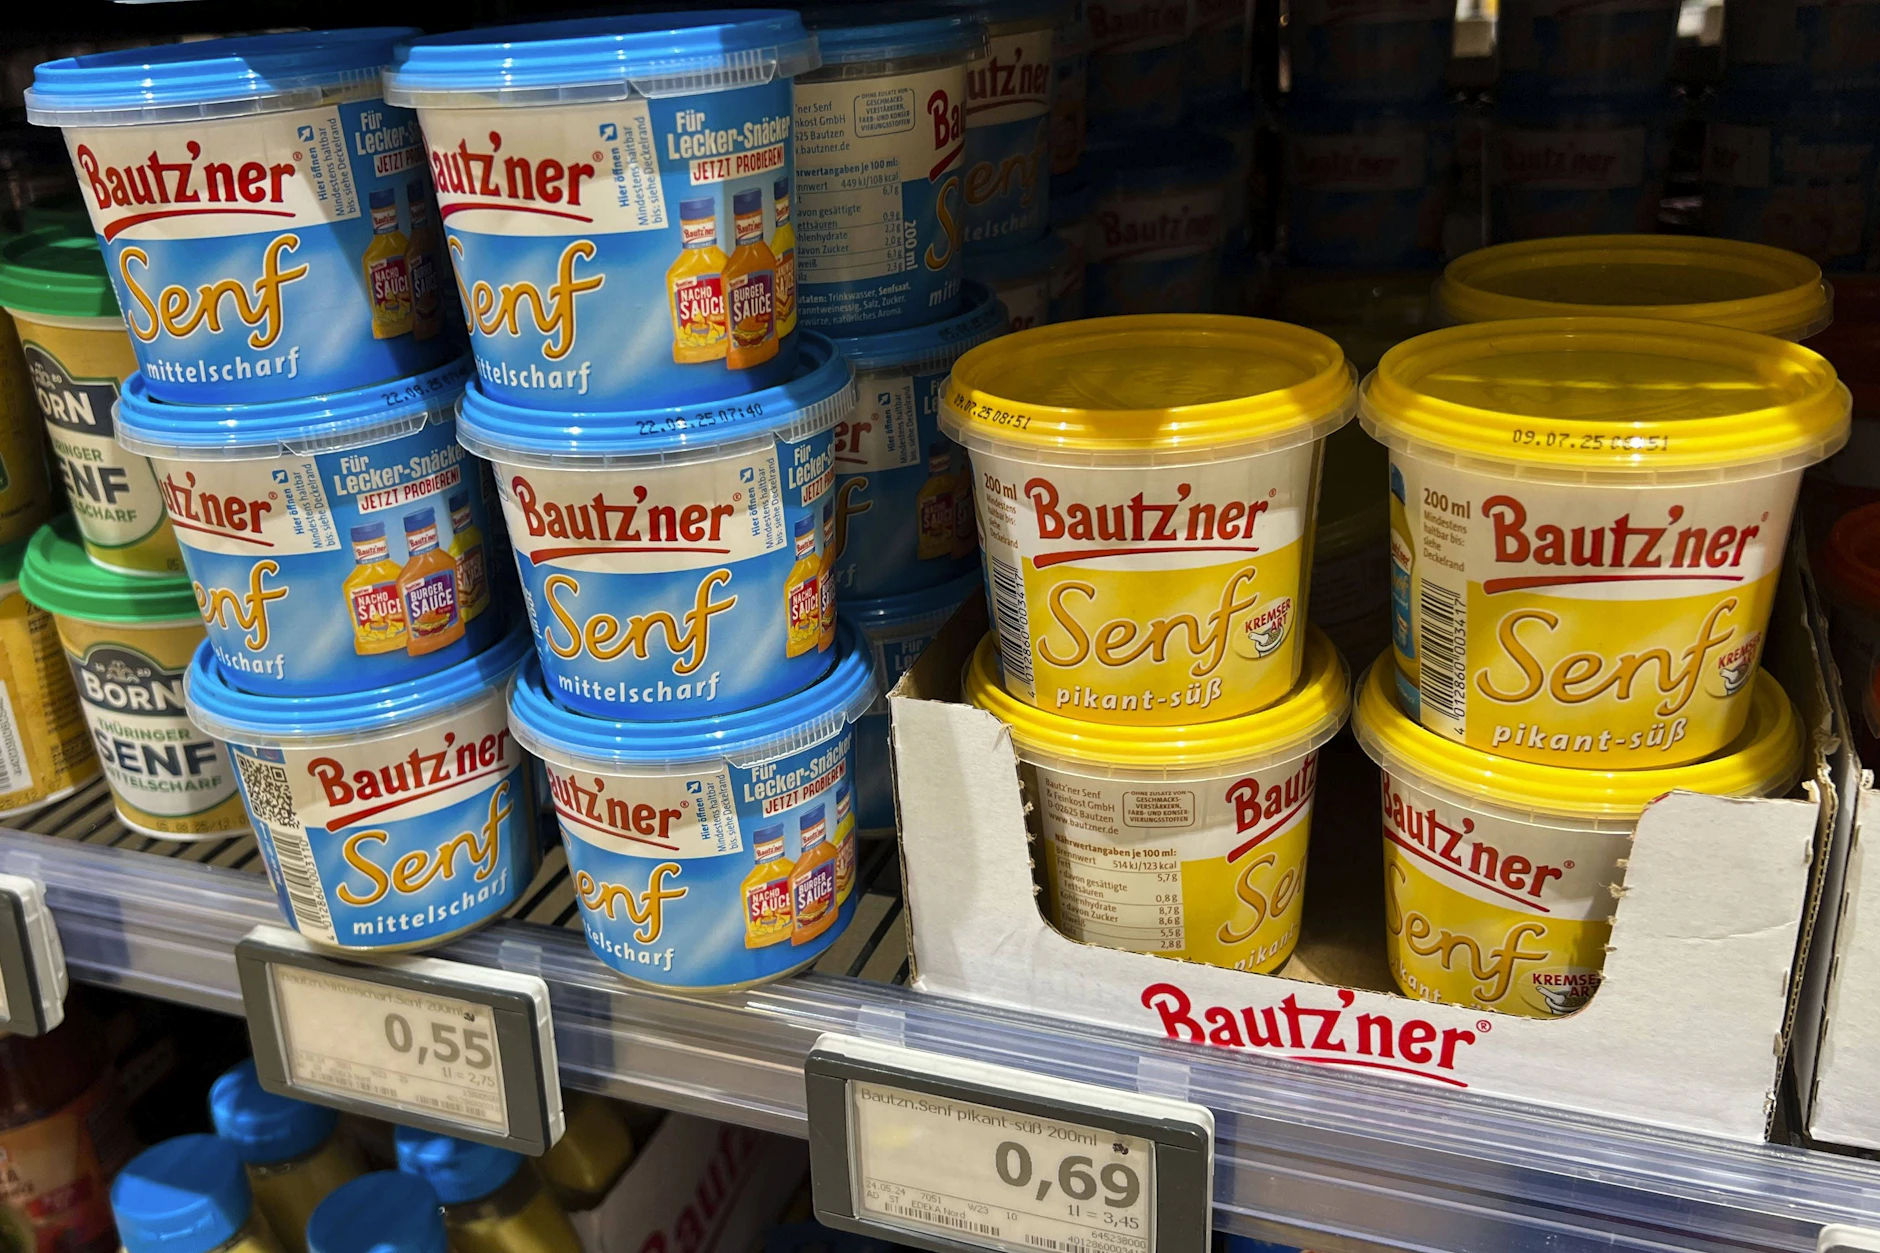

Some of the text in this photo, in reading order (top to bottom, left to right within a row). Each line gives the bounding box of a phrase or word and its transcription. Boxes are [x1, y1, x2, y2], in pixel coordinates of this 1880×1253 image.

[813, 102, 832, 113] Senf
[819, 114, 846, 126] GmbH
[360, 110, 383, 132] Für
[676, 109, 706, 134] Für
[667, 115, 791, 160] Lecker-Snäcker
[810, 129, 844, 141] Bautzen
[327, 117, 353, 196] siehe Deckelrand
[377, 153, 404, 174] JETZT
[634, 116, 659, 203] siehe Deckelrand
[693, 158, 731, 181] JETZT
[309, 147, 328, 201] Hier öffnen
[319, 127, 345, 217] Mindestens haltbar
[611, 147, 630, 208] Hier öffnen
[622, 126, 648, 226] Mindestens haltbar
[819, 204, 861, 219] gesättigte
[822, 244, 849, 254] Zucker
[904, 220, 919, 271] 200 ml
[374, 267, 399, 282] NACHO
[120, 234, 310, 348] Senf
[680, 285, 713, 302] NACHO
[733, 283, 765, 303] BURGER
[733, 293, 772, 322] SAUCE
[146, 346, 301, 384] mittelscharf
[474, 360, 592, 395] ittelscharf
[38, 386, 97, 426] ORN
[954, 393, 1032, 431] 09.07.25 08:51
[1512, 428, 1606, 451] 09.07.25
[340, 454, 370, 475] Für
[794, 444, 811, 466] Für
[767, 458, 779, 505] Deckelrand
[804, 476, 823, 502] JETZT
[985, 473, 1017, 500] 200 ml
[302, 463, 331, 531] siehe Deckelrand
[361, 488, 399, 511] JETZT
[986, 493, 1016, 514] Mindestens
[1424, 488, 1471, 520] 200 ml
[284, 488, 305, 535] Hier öffnen
[293, 472, 323, 549] Mindestens haltbar
[748, 487, 760, 536] Hier öffnen
[988, 506, 1005, 521] haltbar
[1424, 511, 1467, 535] Mindestens
[764, 500, 774, 549] Mindestens
[1424, 523, 1448, 541] haltbar
[990, 528, 1018, 549] Deckelrand
[1424, 536, 1441, 551] siehe
[1424, 547, 1465, 573] Deckelrand
[357, 591, 389, 606] NACHO
[410, 581, 443, 603] BURGER
[411, 588, 454, 618] SAUCE
[793, 586, 812, 606] NACHO
[544, 568, 738, 675] Senf
[1015, 573, 1034, 681] 012860 003417
[1037, 566, 1258, 678] Senf
[1245, 598, 1291, 633] KREMSER
[1270, 614, 1288, 633] ART
[1454, 599, 1467, 717] 012860 003417
[1477, 596, 1737, 718] Senf
[81, 667, 184, 714] BORN
[558, 671, 721, 703] mittelscharf
[1056, 677, 1223, 712] pikant-süß
[97, 716, 191, 740] THÜRINGER
[1492, 716, 1686, 753] pikant-süß
[97, 727, 219, 777] SENF
[744, 732, 852, 803] Lecker-Snäcker
[751, 763, 777, 783] Für
[716, 774, 732, 816] Deckelrand
[1046, 777, 1100, 799] Bautz'ner Senf
[765, 791, 799, 814] JETZT
[1047, 800, 1114, 823] D-02625 Bautzen
[1054, 791, 1115, 812] Feinkost GmbH
[696, 798, 711, 840] Hier öffnen
[707, 782, 726, 852] Mindestens haltbar
[1048, 812, 1119, 835] www.bautzner.de
[336, 780, 514, 908] Senf
[1055, 833, 1177, 857] Nährwertangaben 100 ml:
[1056, 846, 1177, 870] Brennwert 514 kcal
[798, 871, 826, 895] BURGER
[799, 876, 833, 910] SAUCE
[1063, 870, 1128, 892] davon gesättigte
[1064, 880, 1104, 898] Fettsäuren
[353, 868, 509, 936] mittelscharf
[572, 862, 689, 944] enf
[752, 887, 780, 904] NACHO
[1060, 891, 1117, 913] Kohlenhydrate
[1067, 902, 1118, 923] davon Zucker
[384, 1013, 493, 1069] 0,55
[468, 1072, 496, 1089] 2,75
[1048, 1125, 1098, 1147] 200ml
[995, 1139, 1141, 1209] 0,69
[866, 1190, 966, 1219] AD EDEKA Nord
[968, 1203, 989, 1215] W23
[1103, 1212, 1140, 1230] 3,45
